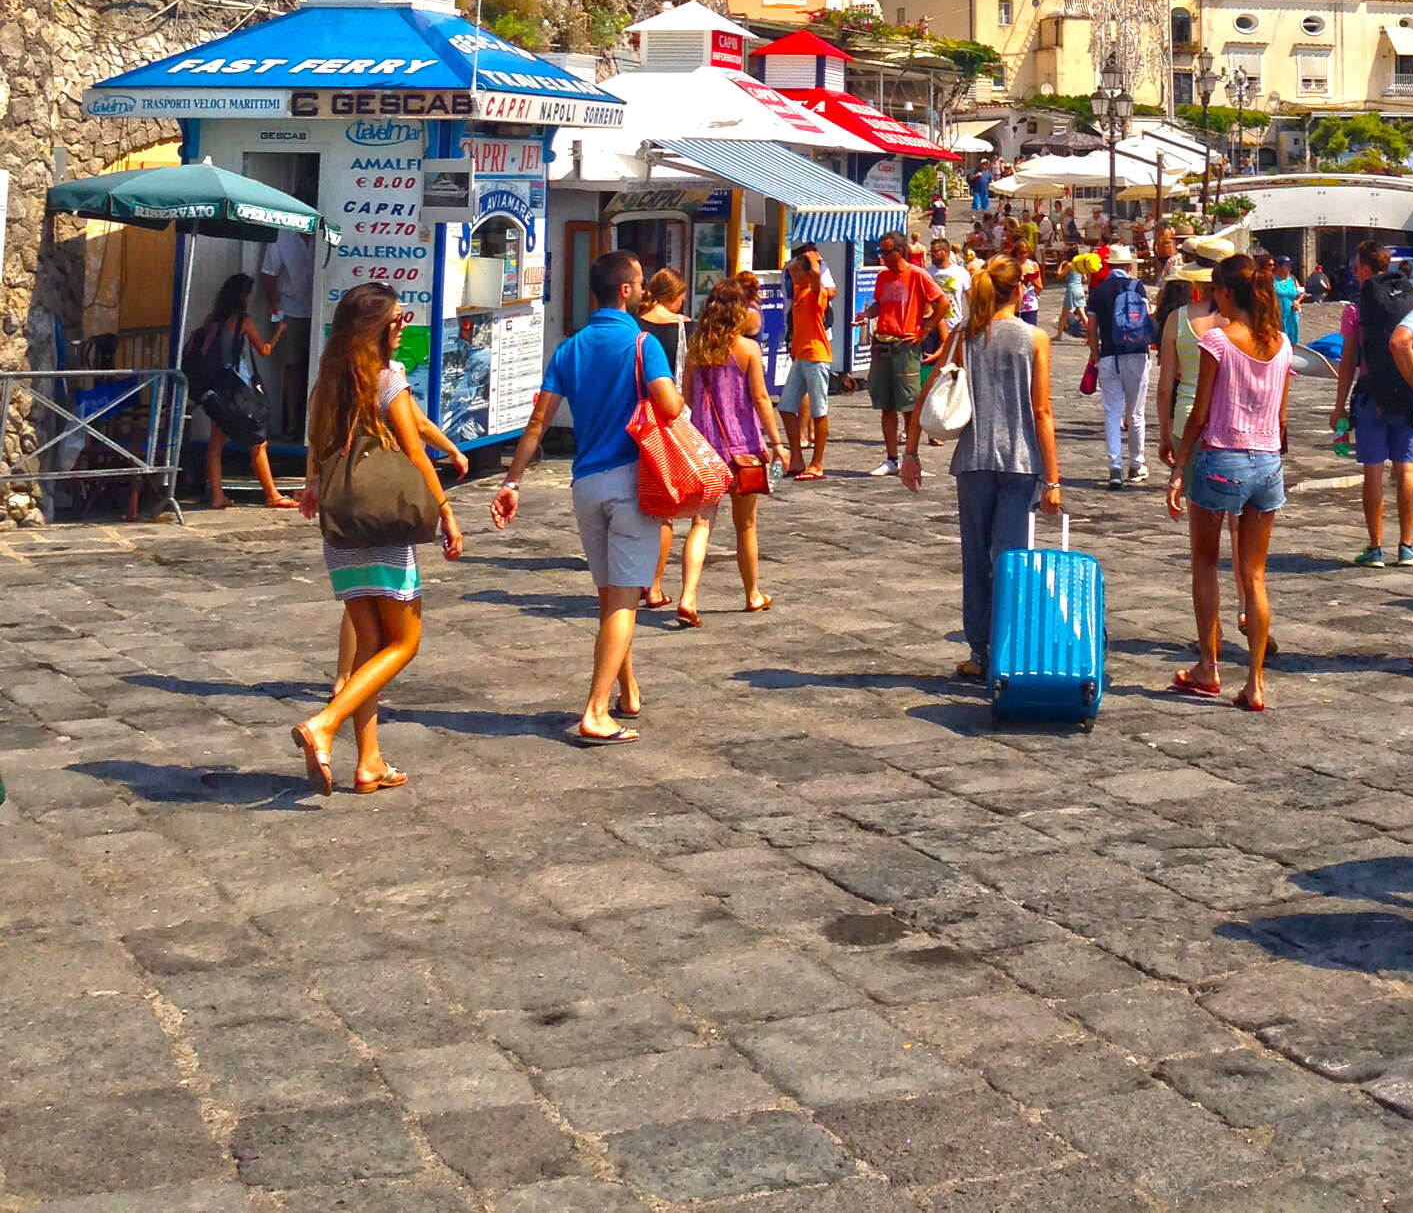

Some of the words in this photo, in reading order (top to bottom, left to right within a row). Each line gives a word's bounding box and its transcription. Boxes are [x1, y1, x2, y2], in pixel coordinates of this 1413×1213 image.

[167, 58, 289, 74] FAST
[288, 58, 439, 75] FERRY
[142, 98, 191, 110] TRASPORTI
[193, 98, 227, 110] VELOCI
[229, 98, 280, 110] MARITTIMI
[331, 94, 474, 116] GESCAB
[486, 96, 531, 119] CAPRI
[539, 103, 576, 122] NAPOLI
[583, 105, 624, 126] SORRENTO
[260, 131, 307, 140] GESCAB
[350, 157, 422, 171] AMALFI
[518, 144, 542, 172] JET
[356, 176, 368, 188] €
[373, 176, 416, 189] 8.00
[134, 205, 215, 219] RISERVATO
[343, 200, 416, 216] CAPRI
[354, 221, 367, 233] €
[369, 221, 416, 236] 17.70
[337, 244, 427, 259] SALERNO
[352, 266, 364, 278] €
[368, 266, 419, 280] 12.00
